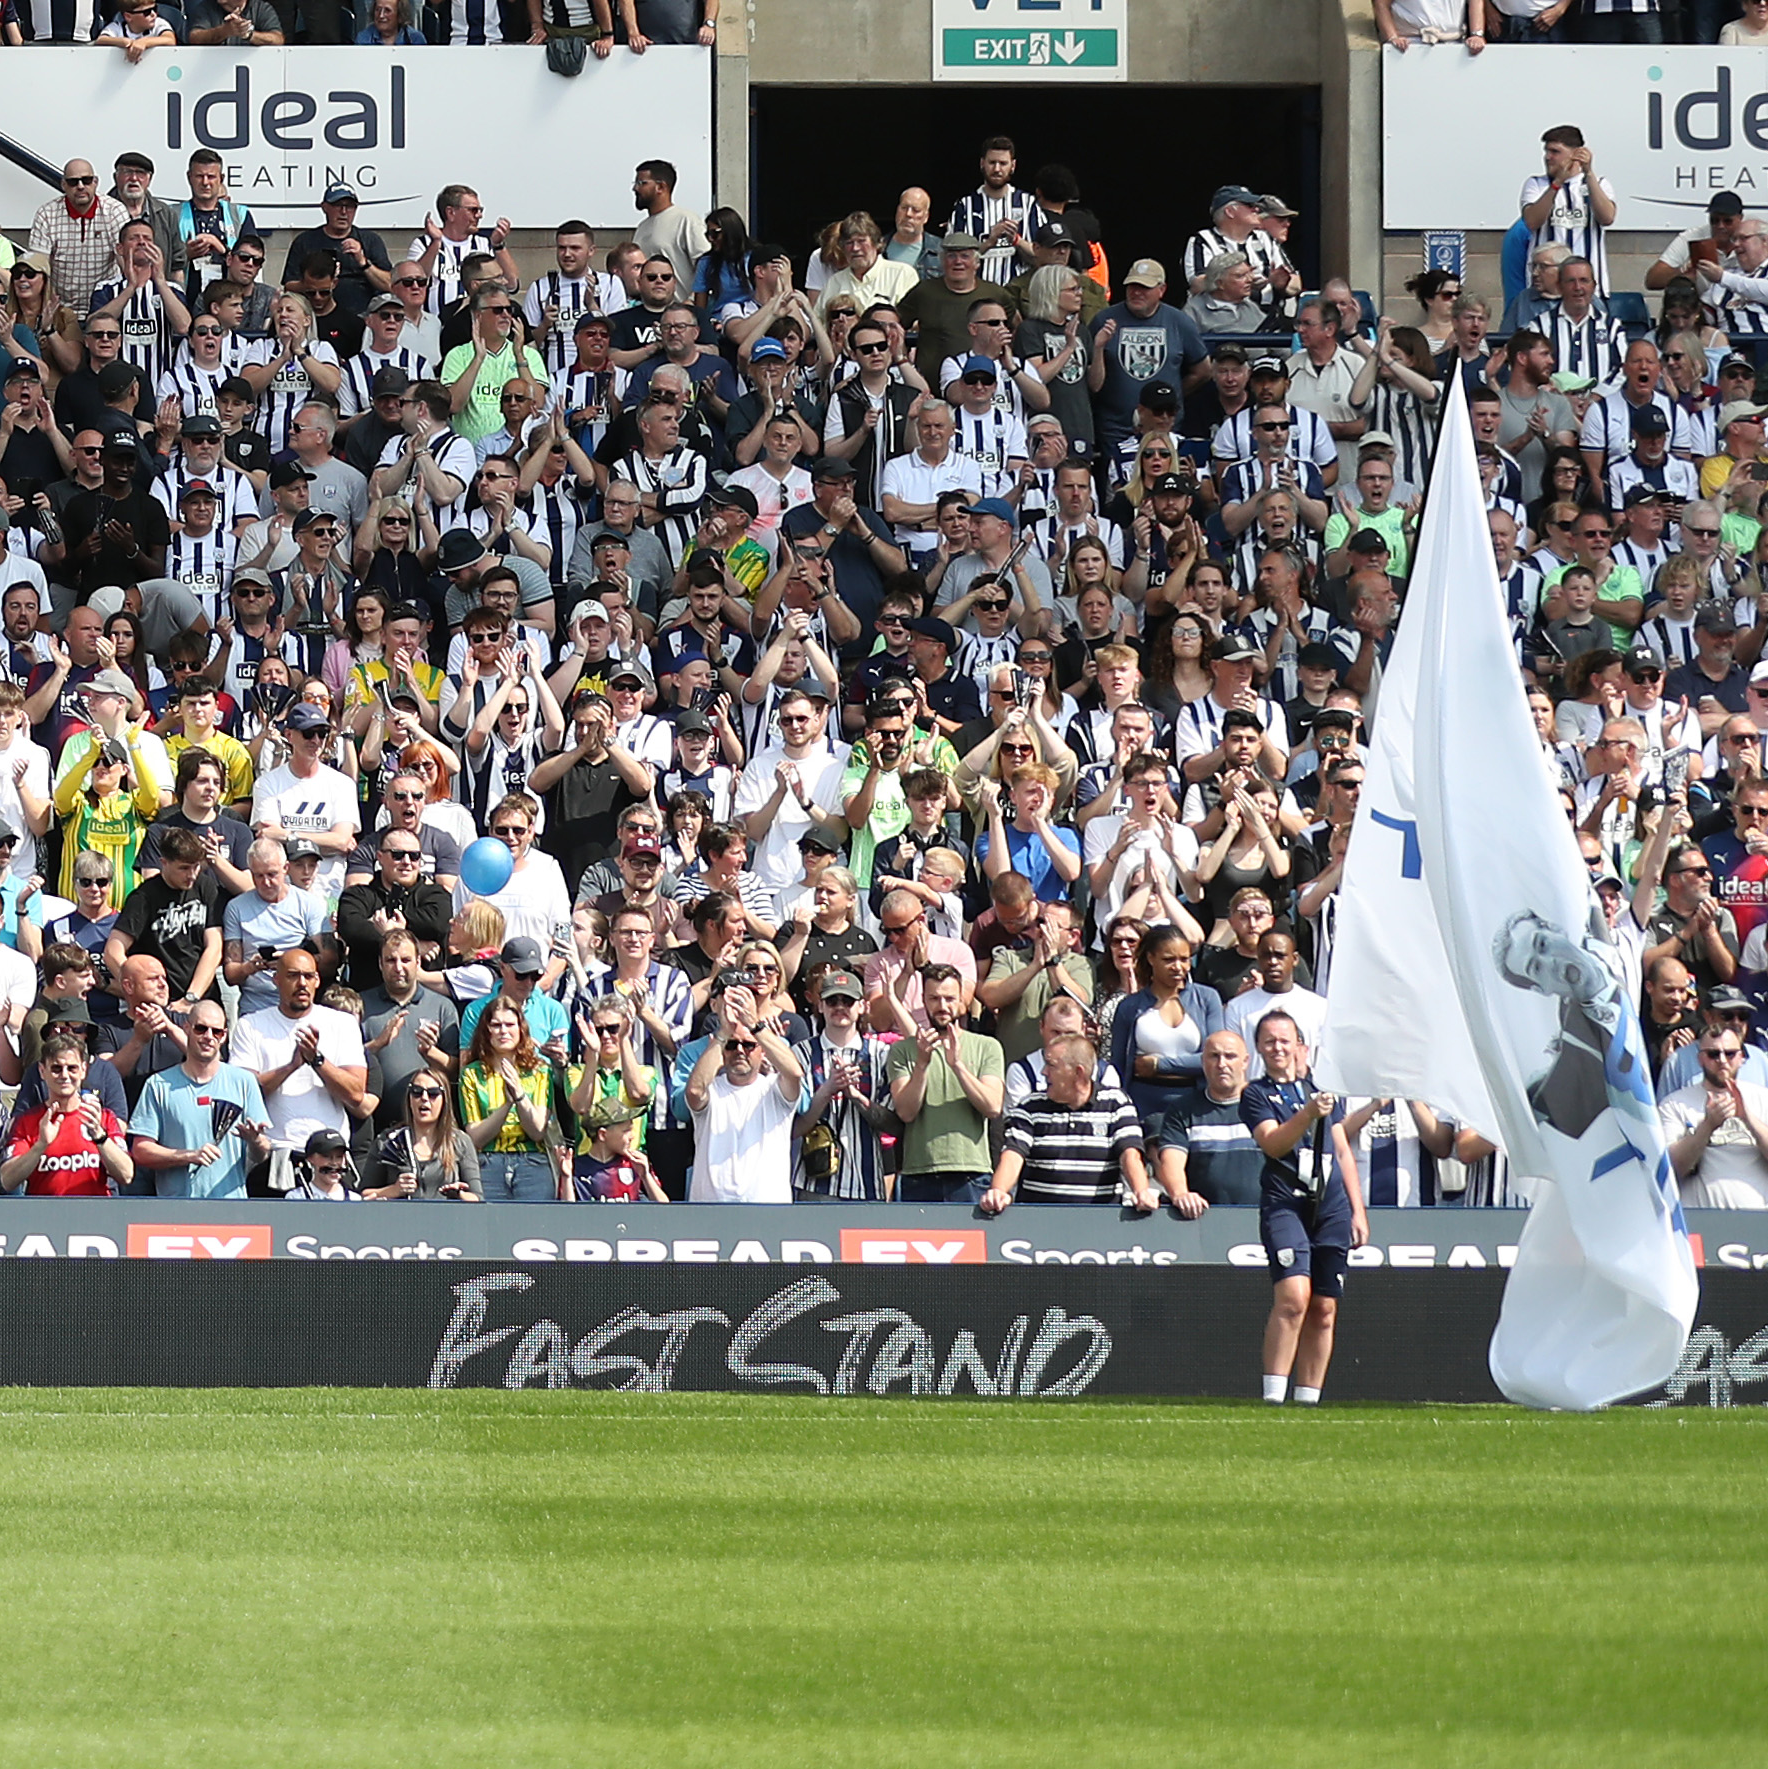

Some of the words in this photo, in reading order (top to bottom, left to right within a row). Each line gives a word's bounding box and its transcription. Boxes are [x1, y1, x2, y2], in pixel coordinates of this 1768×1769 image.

[974, 37, 1024, 62] EXIT
[165, 64, 407, 150] ideal
[1647, 65, 1768, 152] ide
[226, 164, 379, 189] EATING
[1676, 167, 1768, 189] HEAT
[126, 322, 155, 335] ideal
[1123, 334, 1163, 345] ALBION
[178, 571, 220, 586] ideal
[90, 819, 127, 834] ideal
[1719, 875, 1767, 895] ideal
[1725, 894, 1763, 902] HEATING
[40, 1150, 100, 1172] Zoopla
[726, 1274, 1113, 1396] STAND
